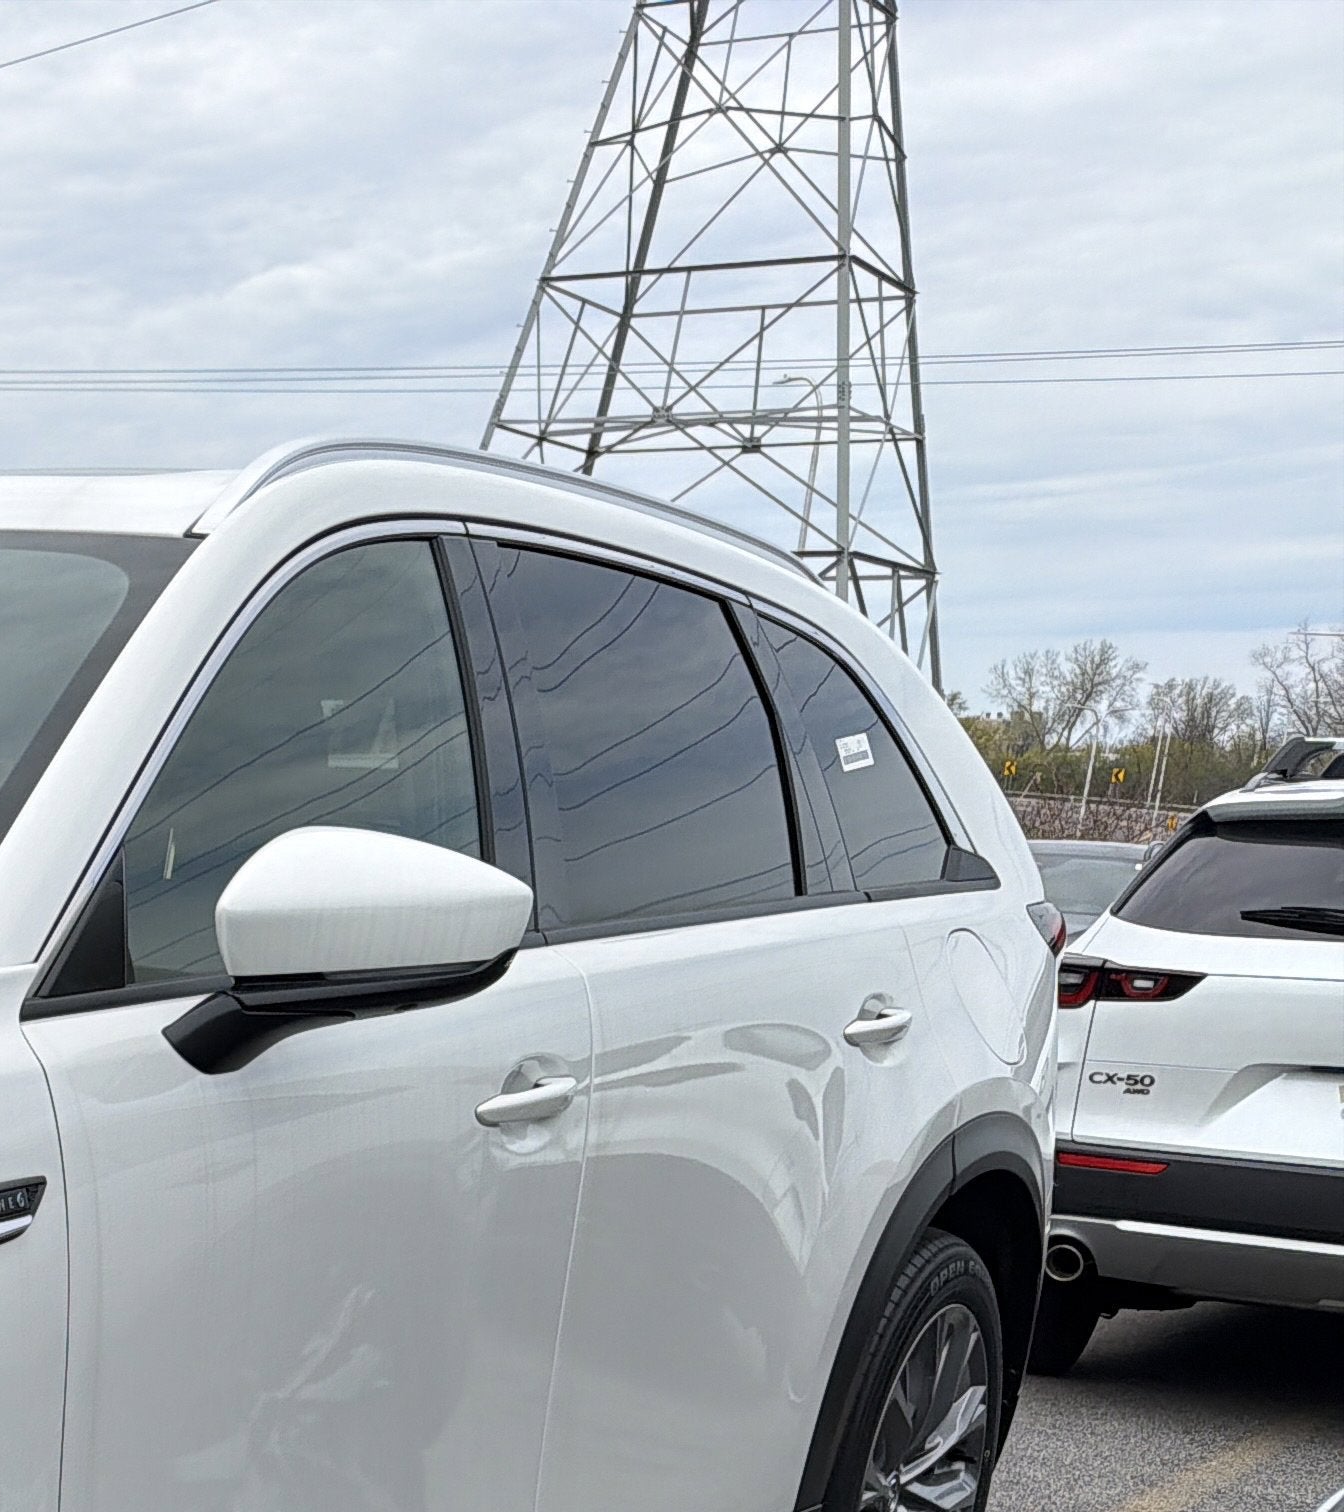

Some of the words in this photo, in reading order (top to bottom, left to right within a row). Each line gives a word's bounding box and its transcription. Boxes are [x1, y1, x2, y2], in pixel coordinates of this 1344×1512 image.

[1088, 1071, 1156, 1088] CX-50
[1122, 1087, 1151, 1096] AWD
[930, 1259, 965, 1297] OPEN
